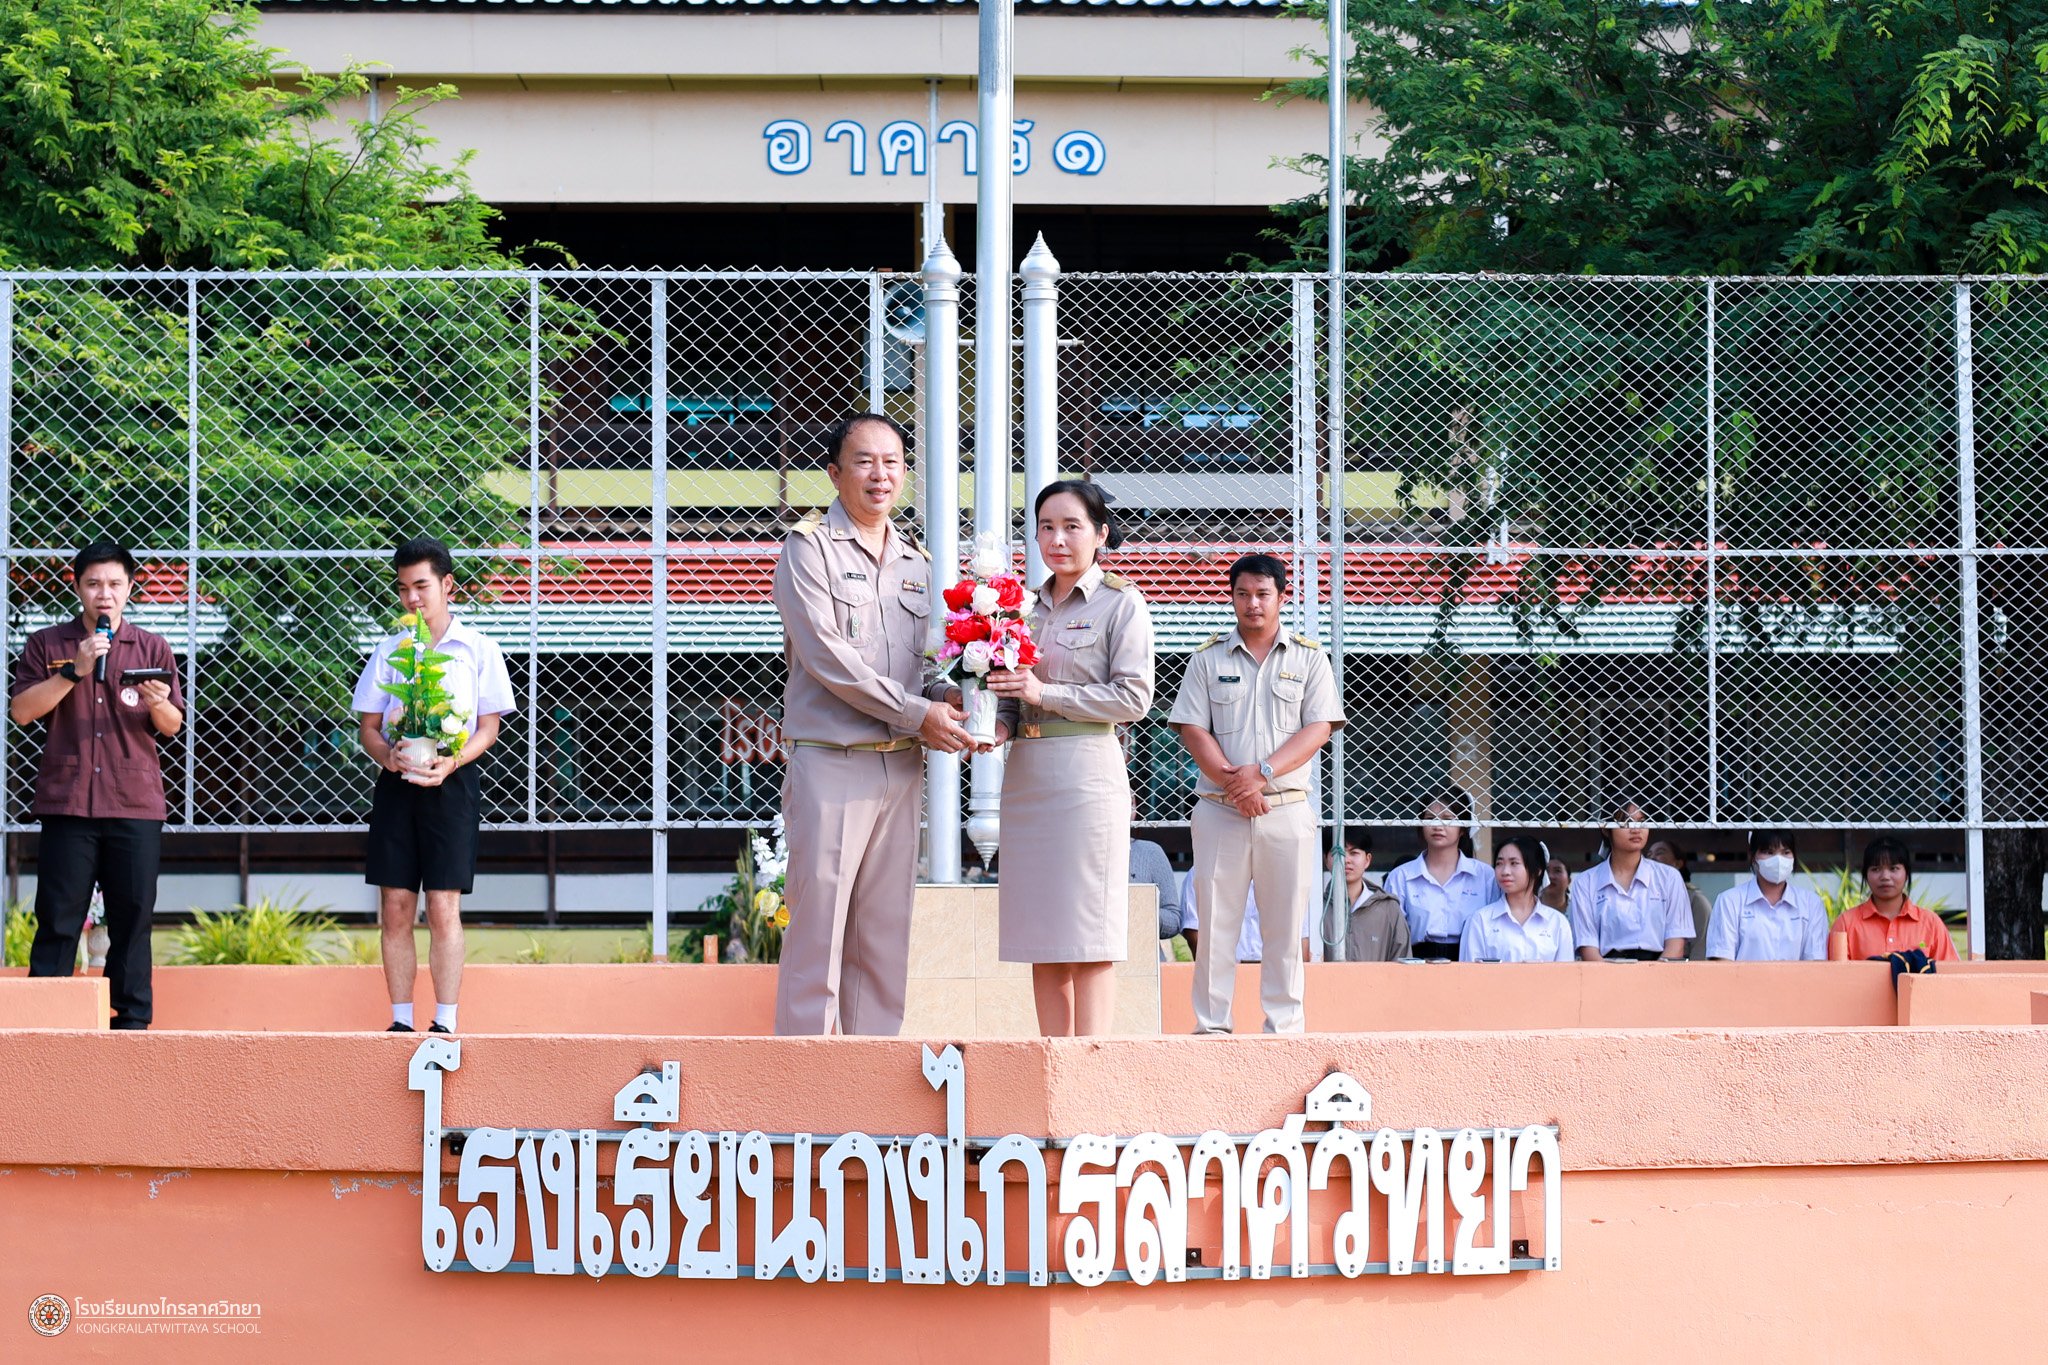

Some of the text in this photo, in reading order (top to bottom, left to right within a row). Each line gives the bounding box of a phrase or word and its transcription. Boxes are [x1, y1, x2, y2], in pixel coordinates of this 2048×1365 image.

[1053, 130, 1106, 176] ๑
[408, 1037, 1562, 1288] โรงเรียนกงไกรลาศวิทยา
